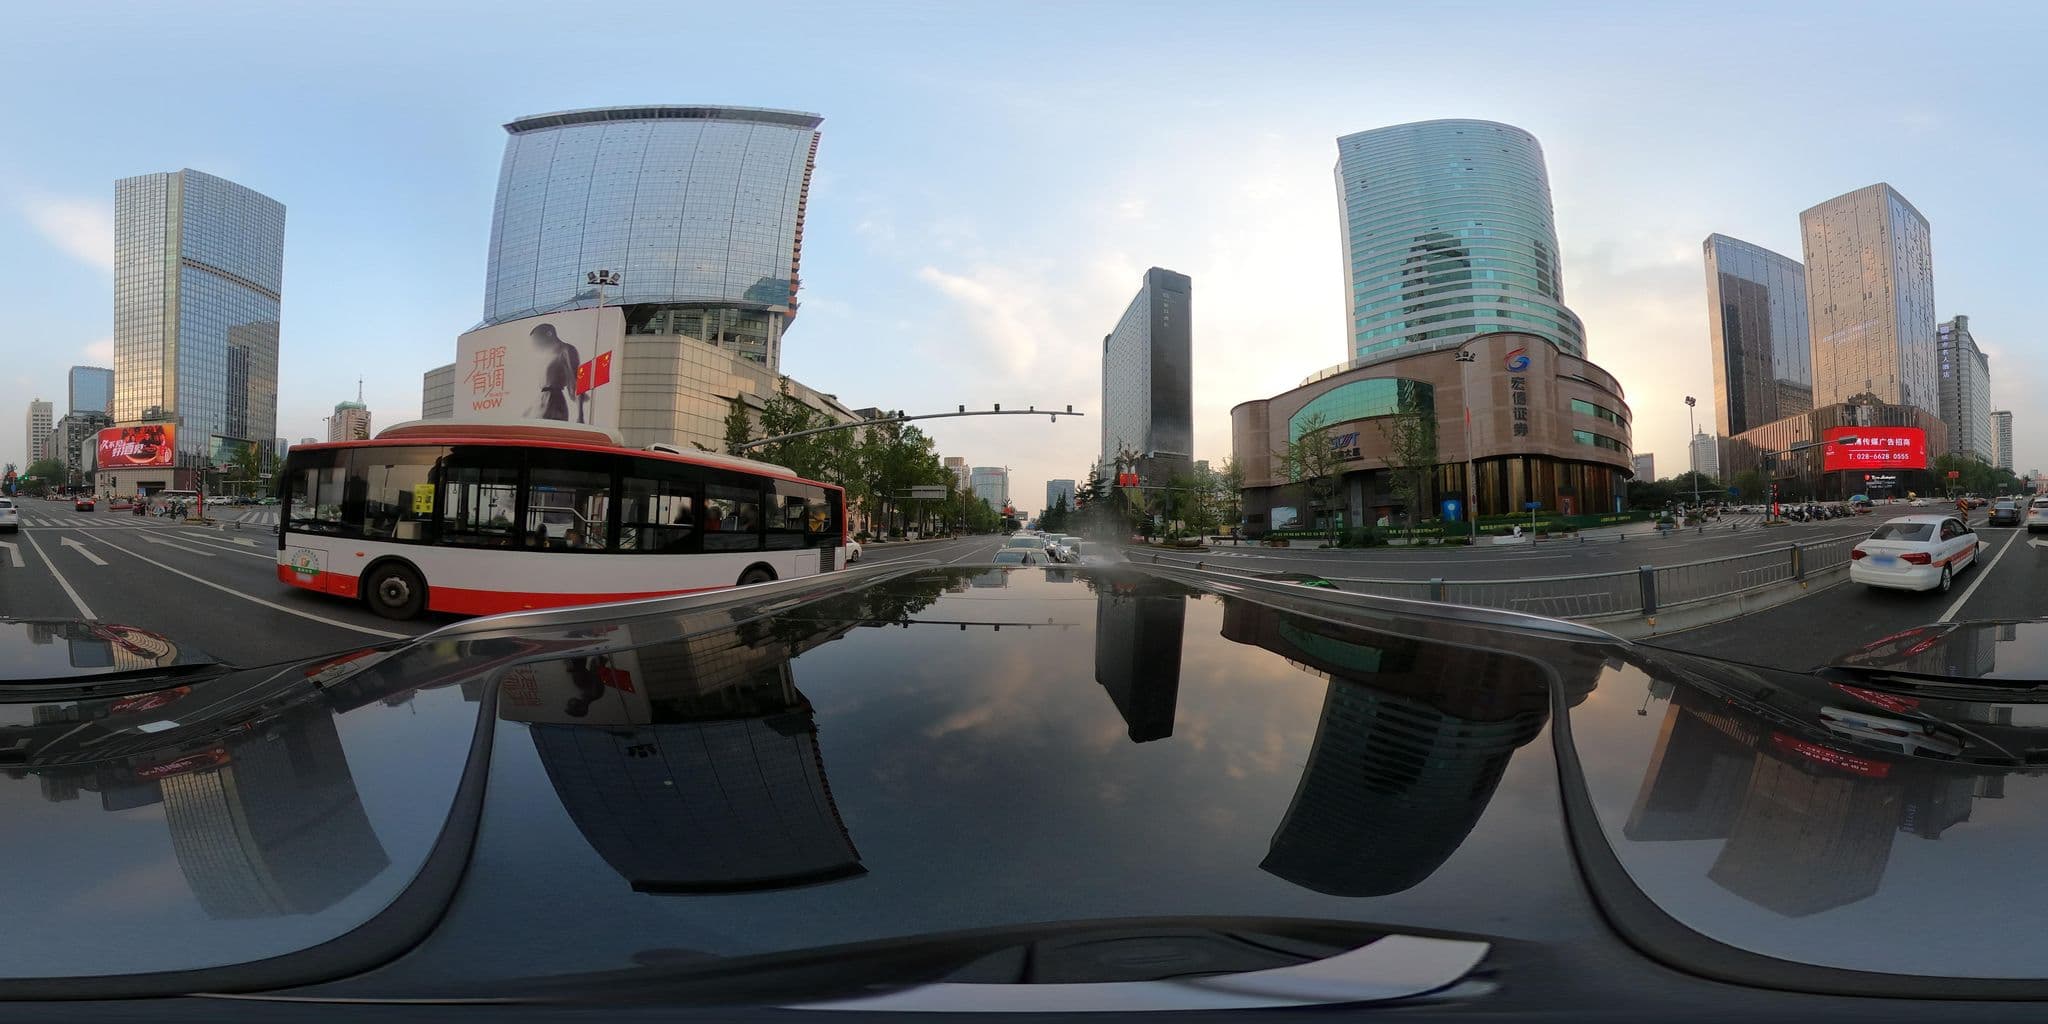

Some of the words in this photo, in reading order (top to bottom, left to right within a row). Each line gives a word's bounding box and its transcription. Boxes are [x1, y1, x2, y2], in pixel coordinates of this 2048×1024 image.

[465, 346, 506, 380] 开腔
[472, 368, 504, 397] 有调
[472, 398, 502, 411] WOW
[1511, 377, 1528, 436] 宏信证券
